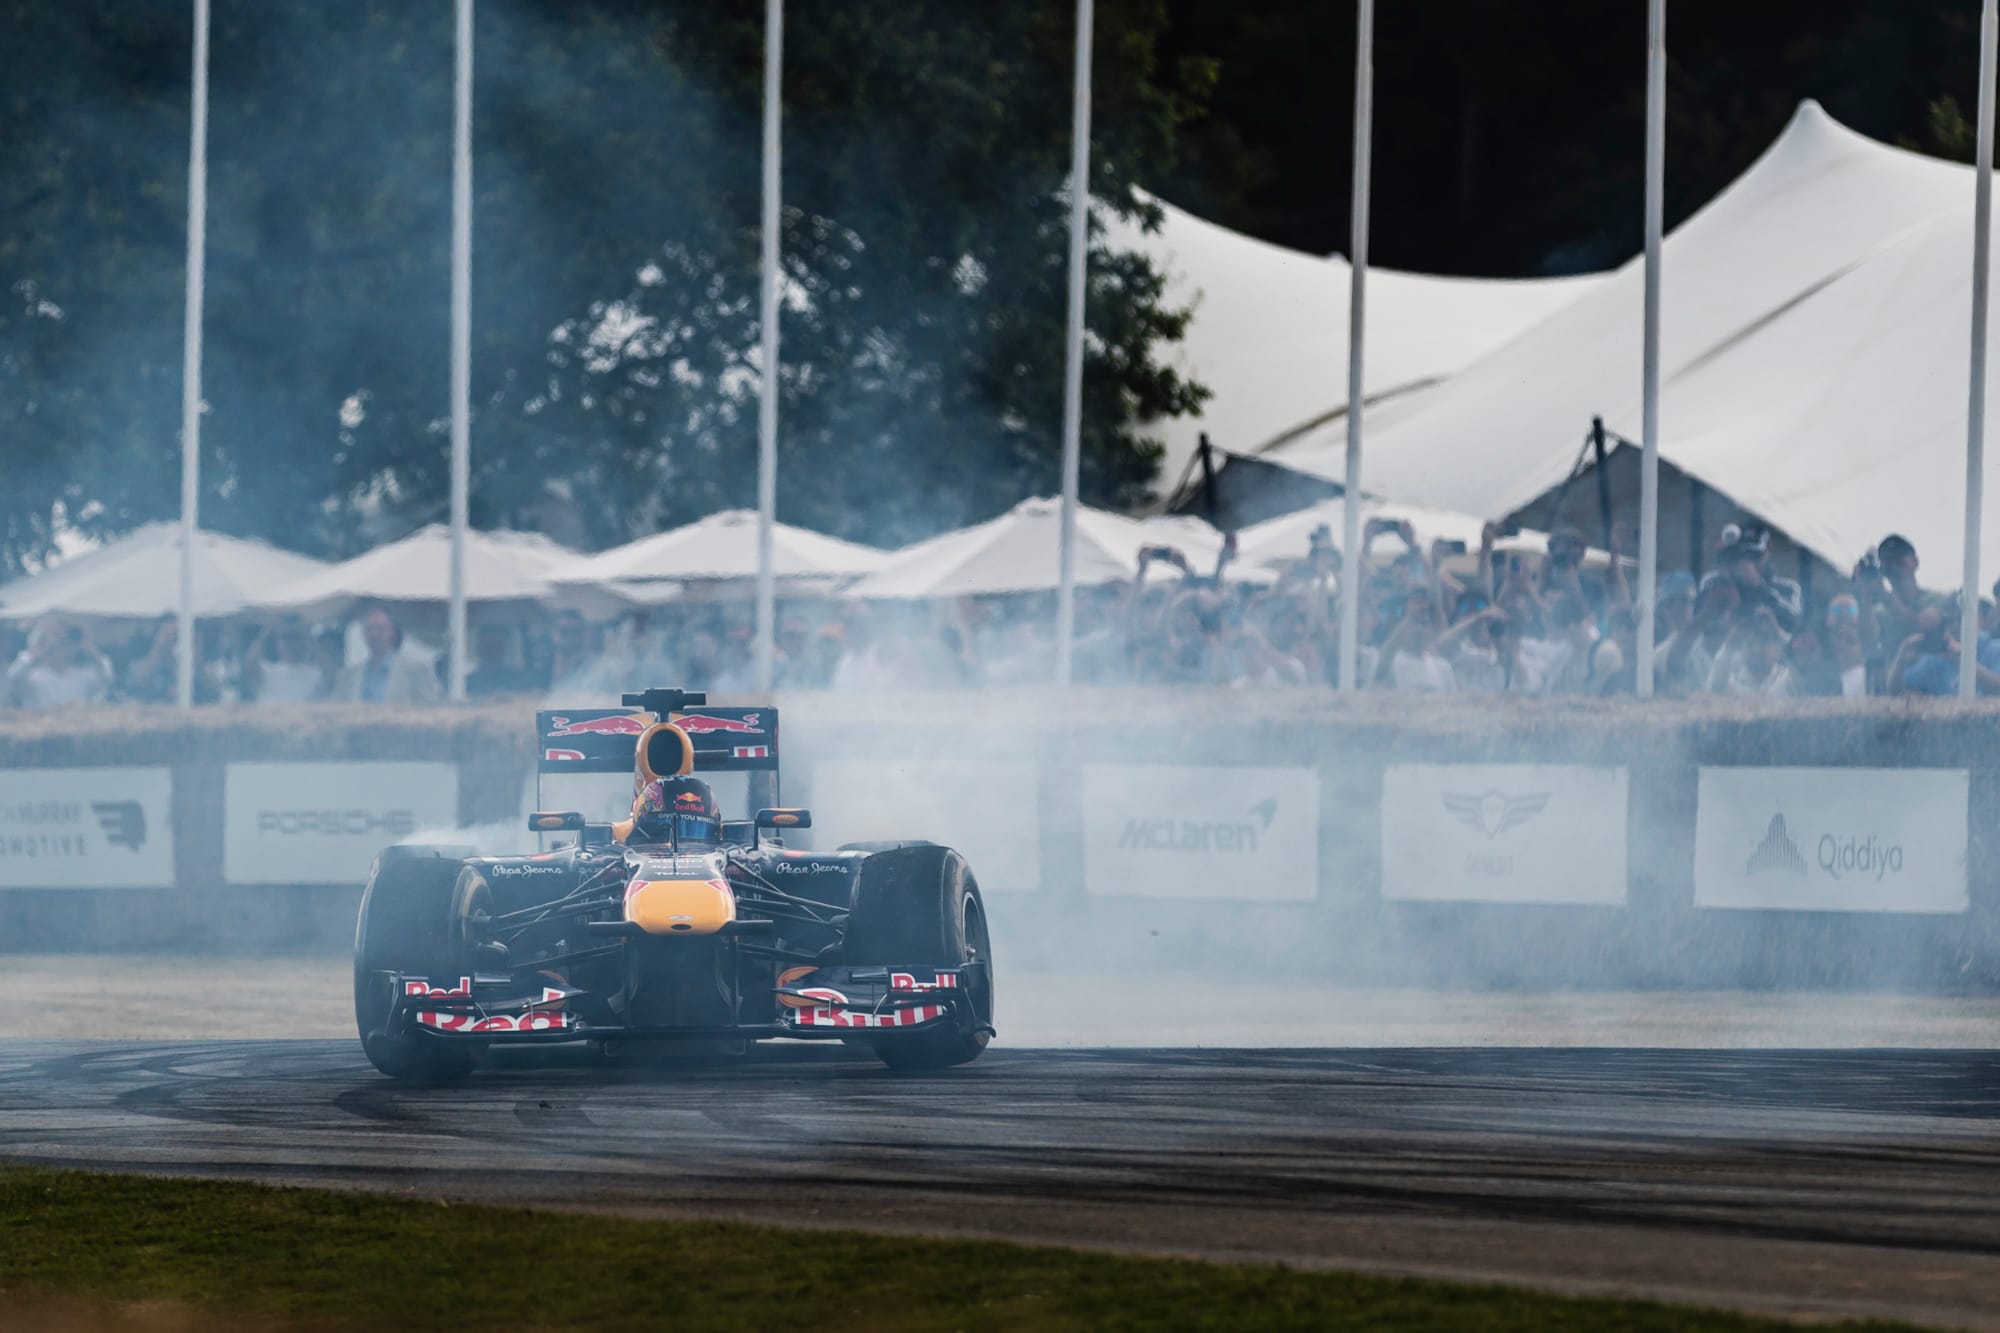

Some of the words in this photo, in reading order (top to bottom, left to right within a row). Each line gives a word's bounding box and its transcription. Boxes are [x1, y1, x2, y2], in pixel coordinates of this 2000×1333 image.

[690, 804, 705, 813] Bull
[257, 809, 416, 835] PORSCHE
[1118, 818, 1257, 851] McLaren
[1818, 833, 1903, 882] Qiddiya
[492, 864, 522, 878] Pepe
[522, 864, 563, 878] Jeans
[776, 862, 809, 875] Pepe
[810, 862, 849, 875] Jeans
